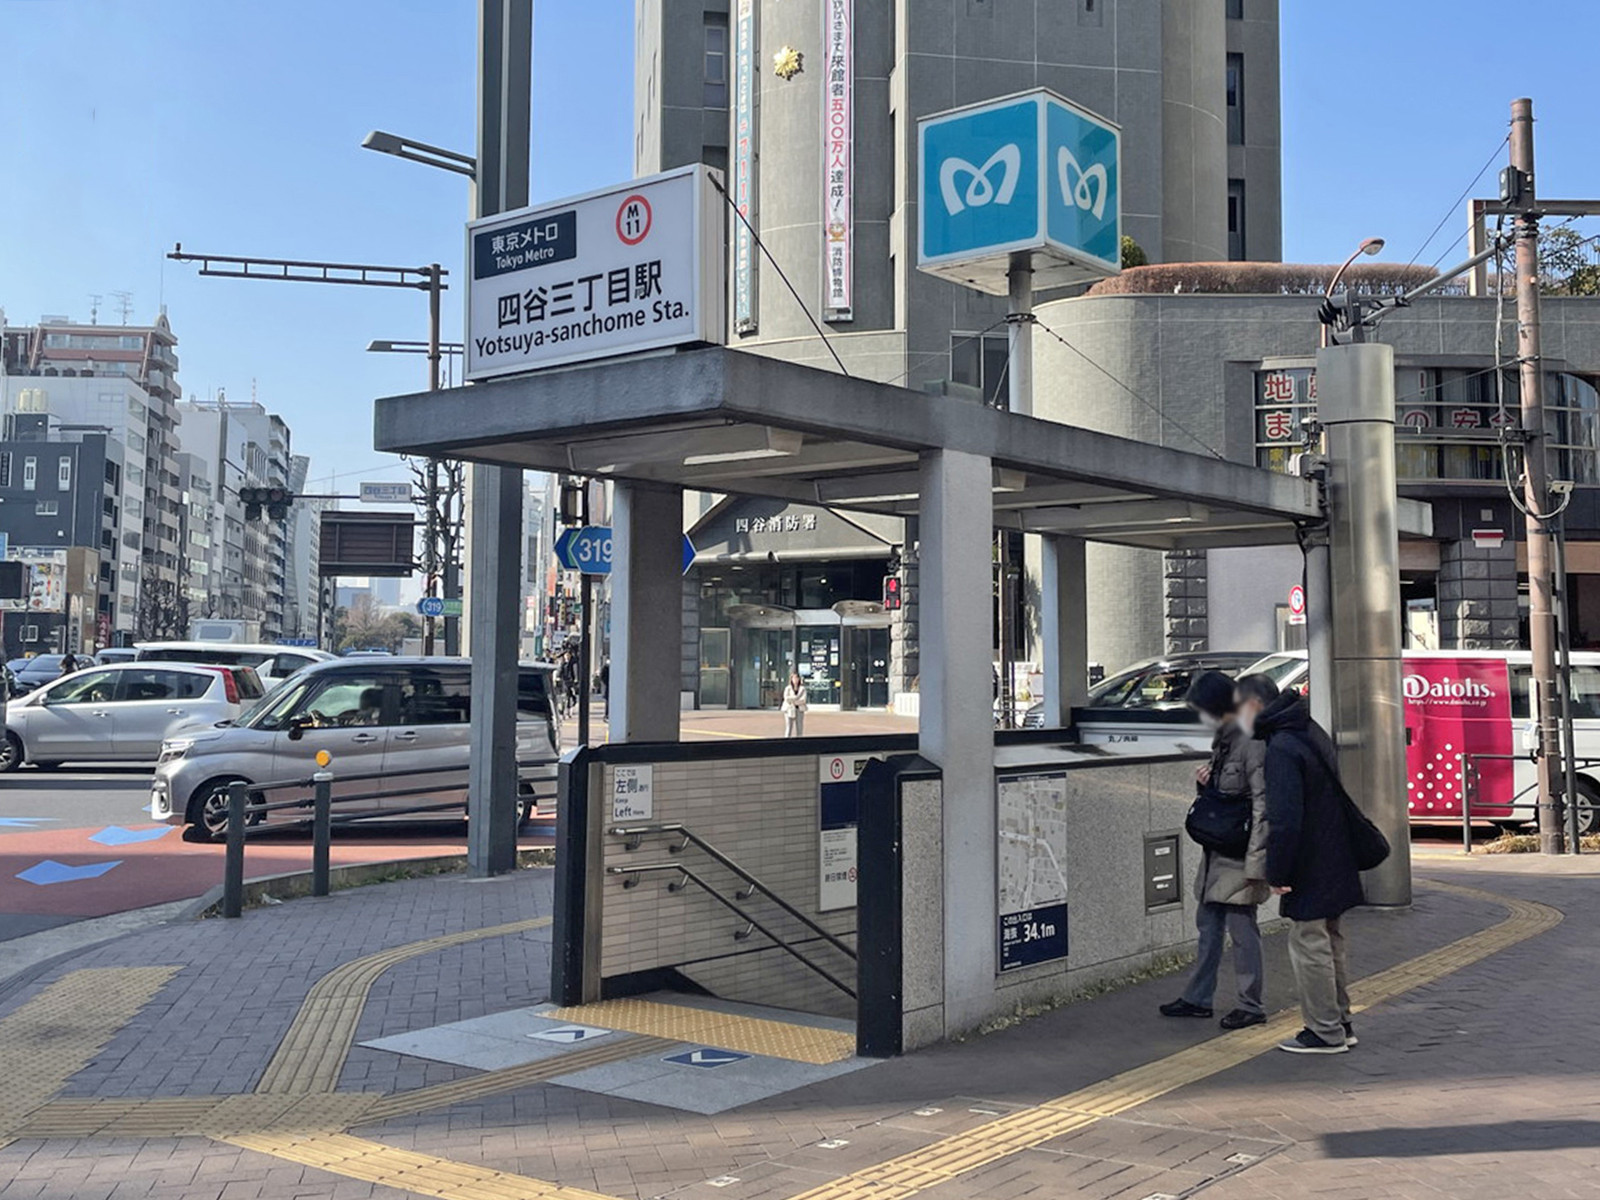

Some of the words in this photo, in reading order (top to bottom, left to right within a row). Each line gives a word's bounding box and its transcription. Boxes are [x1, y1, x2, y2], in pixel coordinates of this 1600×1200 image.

[627, 204, 639, 219] M
[626, 219, 640, 235] 11
[491, 222, 558, 255] 東京メトロ
[496, 254, 523, 269] Tokyo
[525, 246, 555, 263] Metro
[497, 259, 662, 330] 四谷三丁目駅
[475, 308, 646, 358] Yotsuya-sanchome
[652, 300, 690, 323] Sta.
[736, 513, 817, 533] 四谷消防署
[579, 538, 613, 563] 319
[615, 806, 632, 818] Left
[1023, 922, 1056, 942] 34.1m
